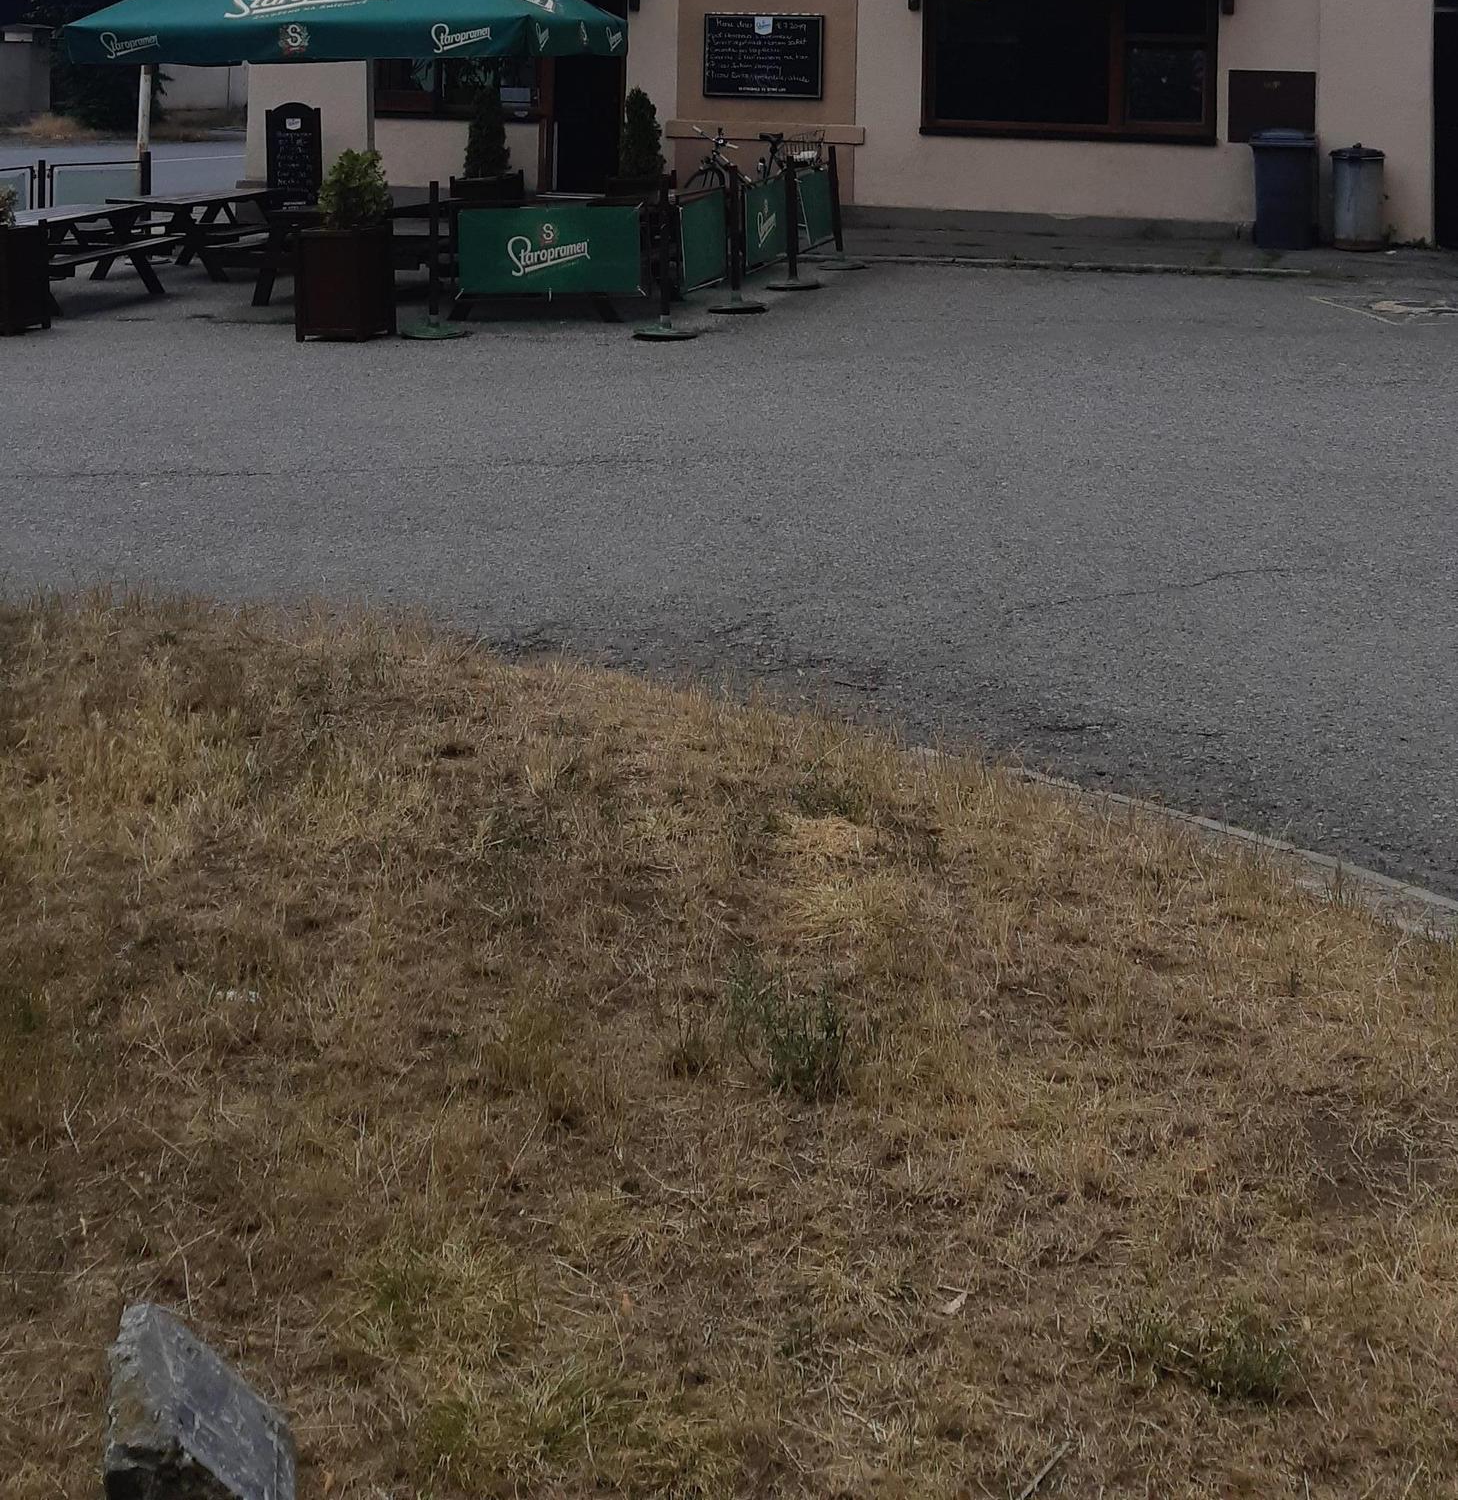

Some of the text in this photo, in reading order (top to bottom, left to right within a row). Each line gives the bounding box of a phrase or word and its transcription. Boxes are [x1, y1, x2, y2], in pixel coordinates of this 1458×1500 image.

[100, 31, 160, 59] Staropramen
[431, 23, 492, 53] Staropramen
[507, 235, 590, 276] Staropramen
